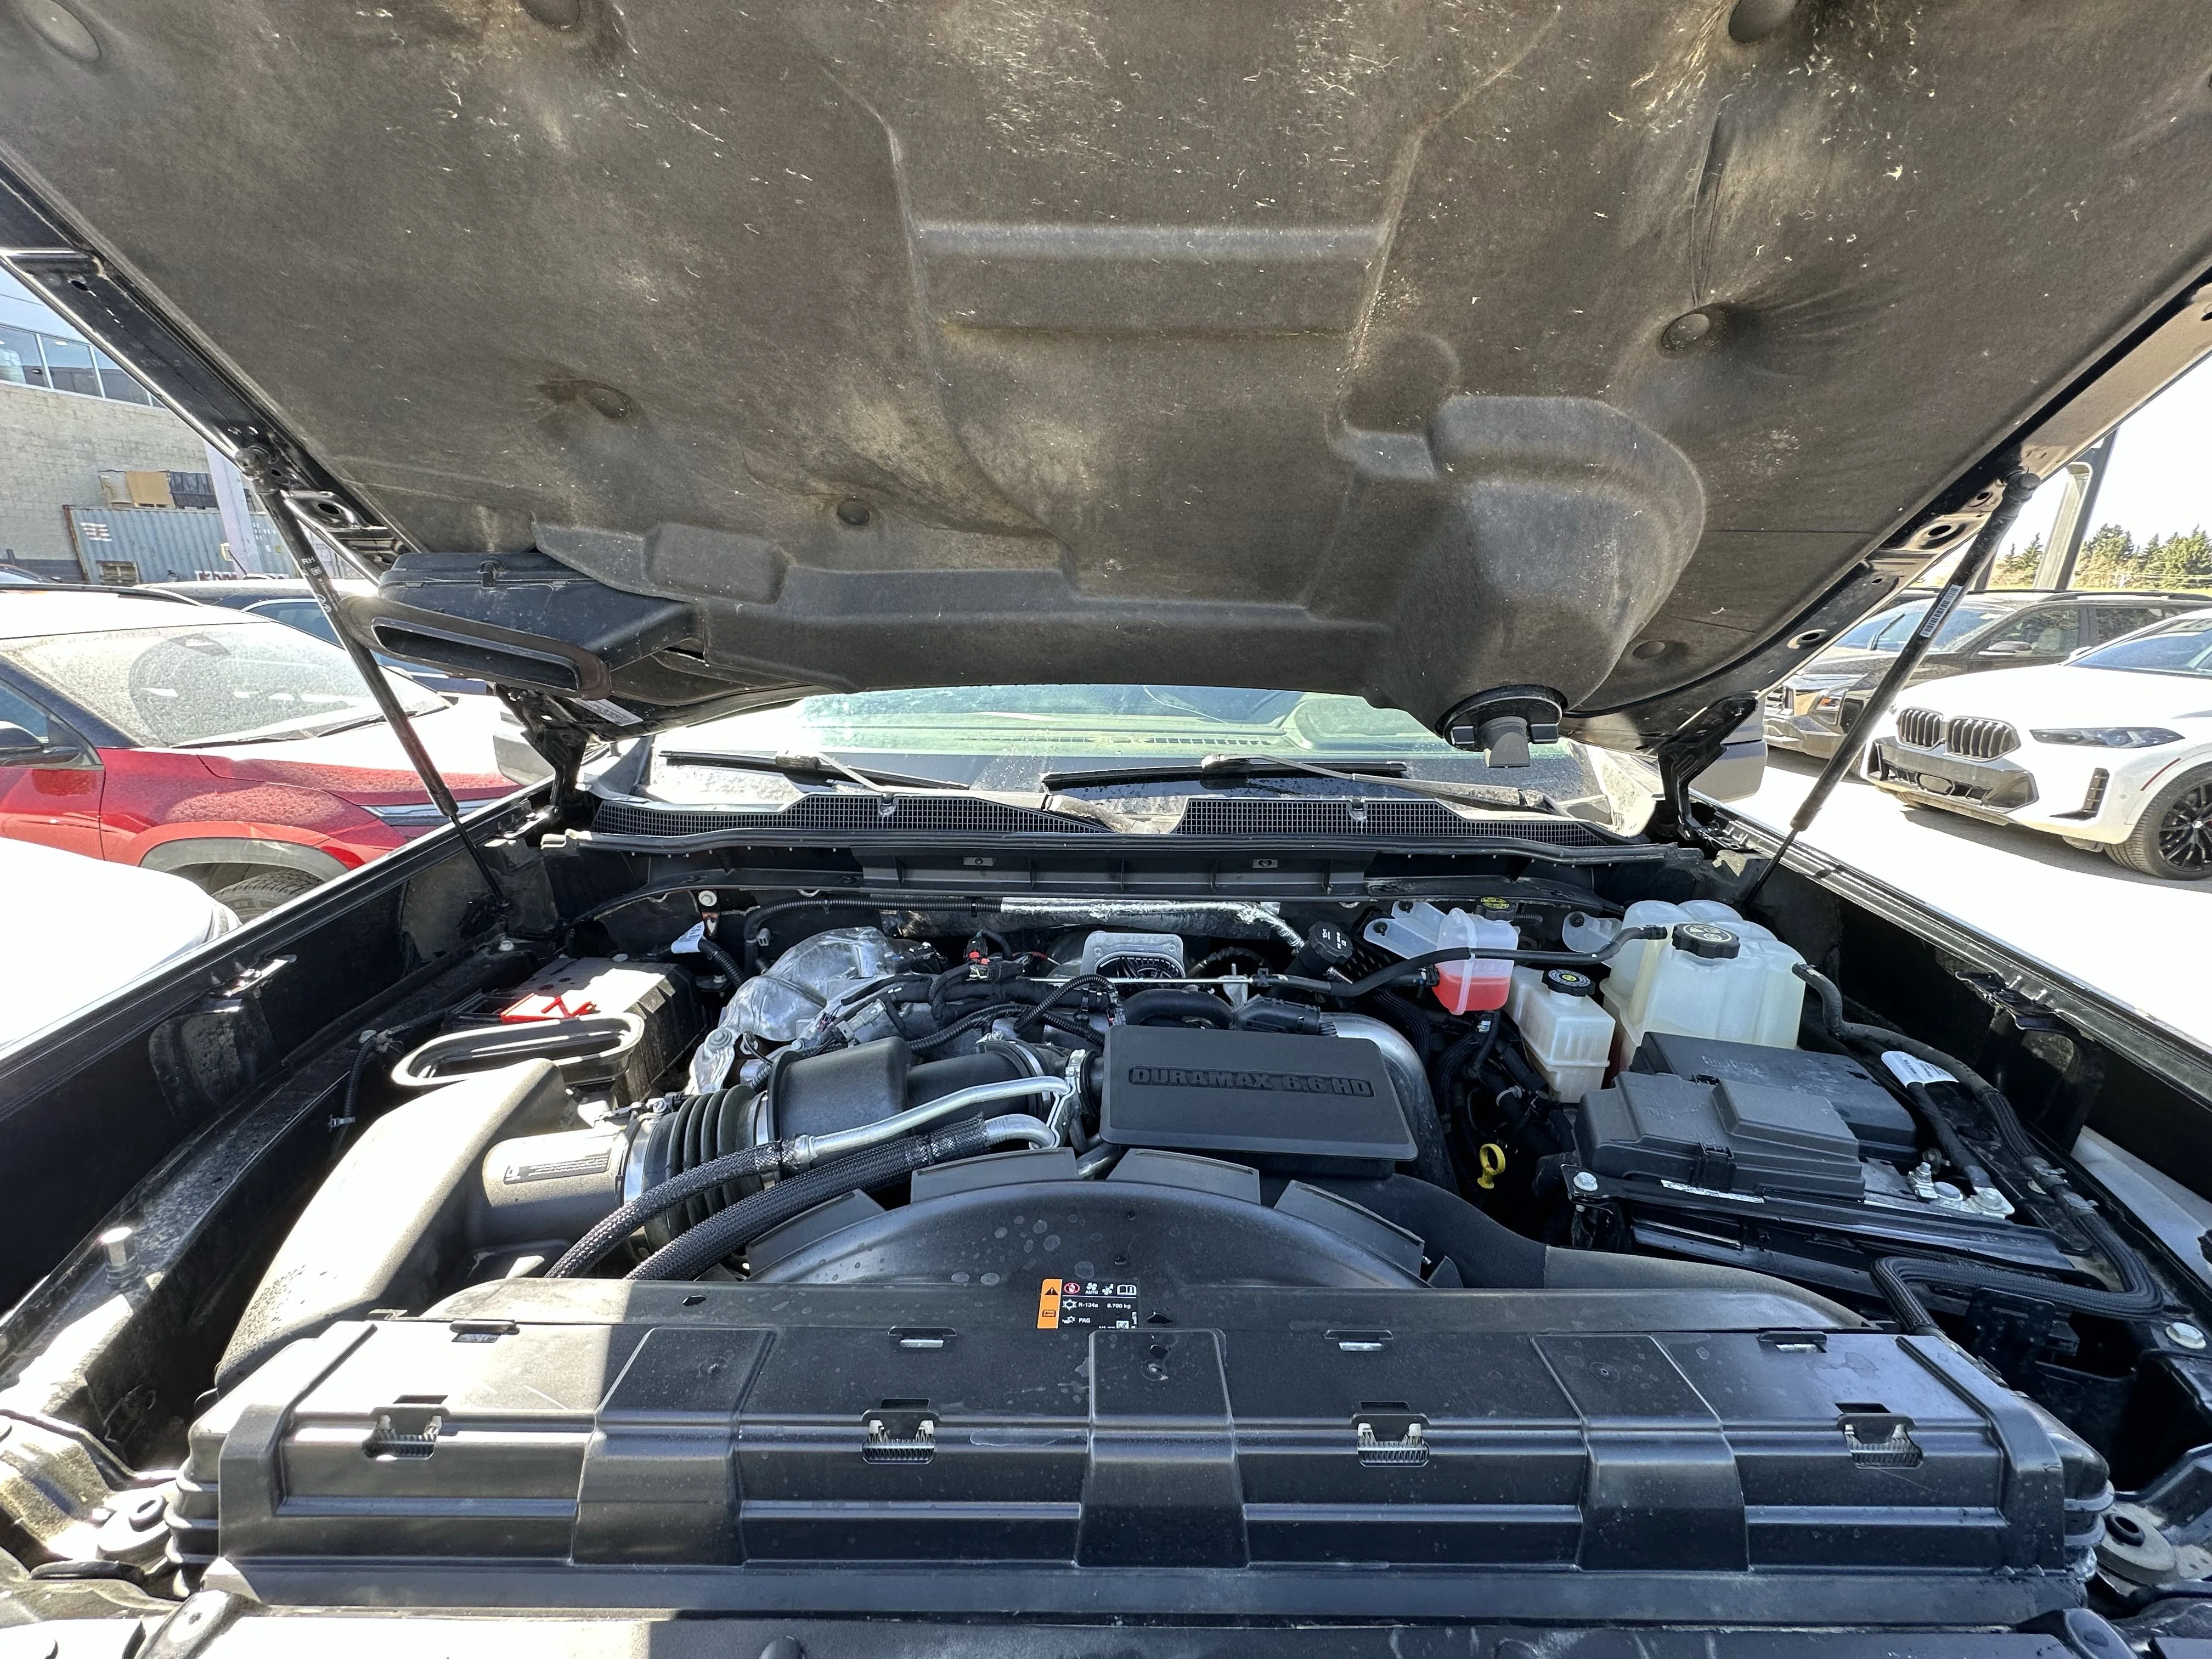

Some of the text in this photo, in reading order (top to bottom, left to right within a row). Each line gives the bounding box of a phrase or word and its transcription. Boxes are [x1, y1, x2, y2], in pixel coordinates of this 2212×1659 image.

[301, 556, 315, 565] RH
[1132, 1068, 1372, 1095] DURAMAX 6.6 HD
